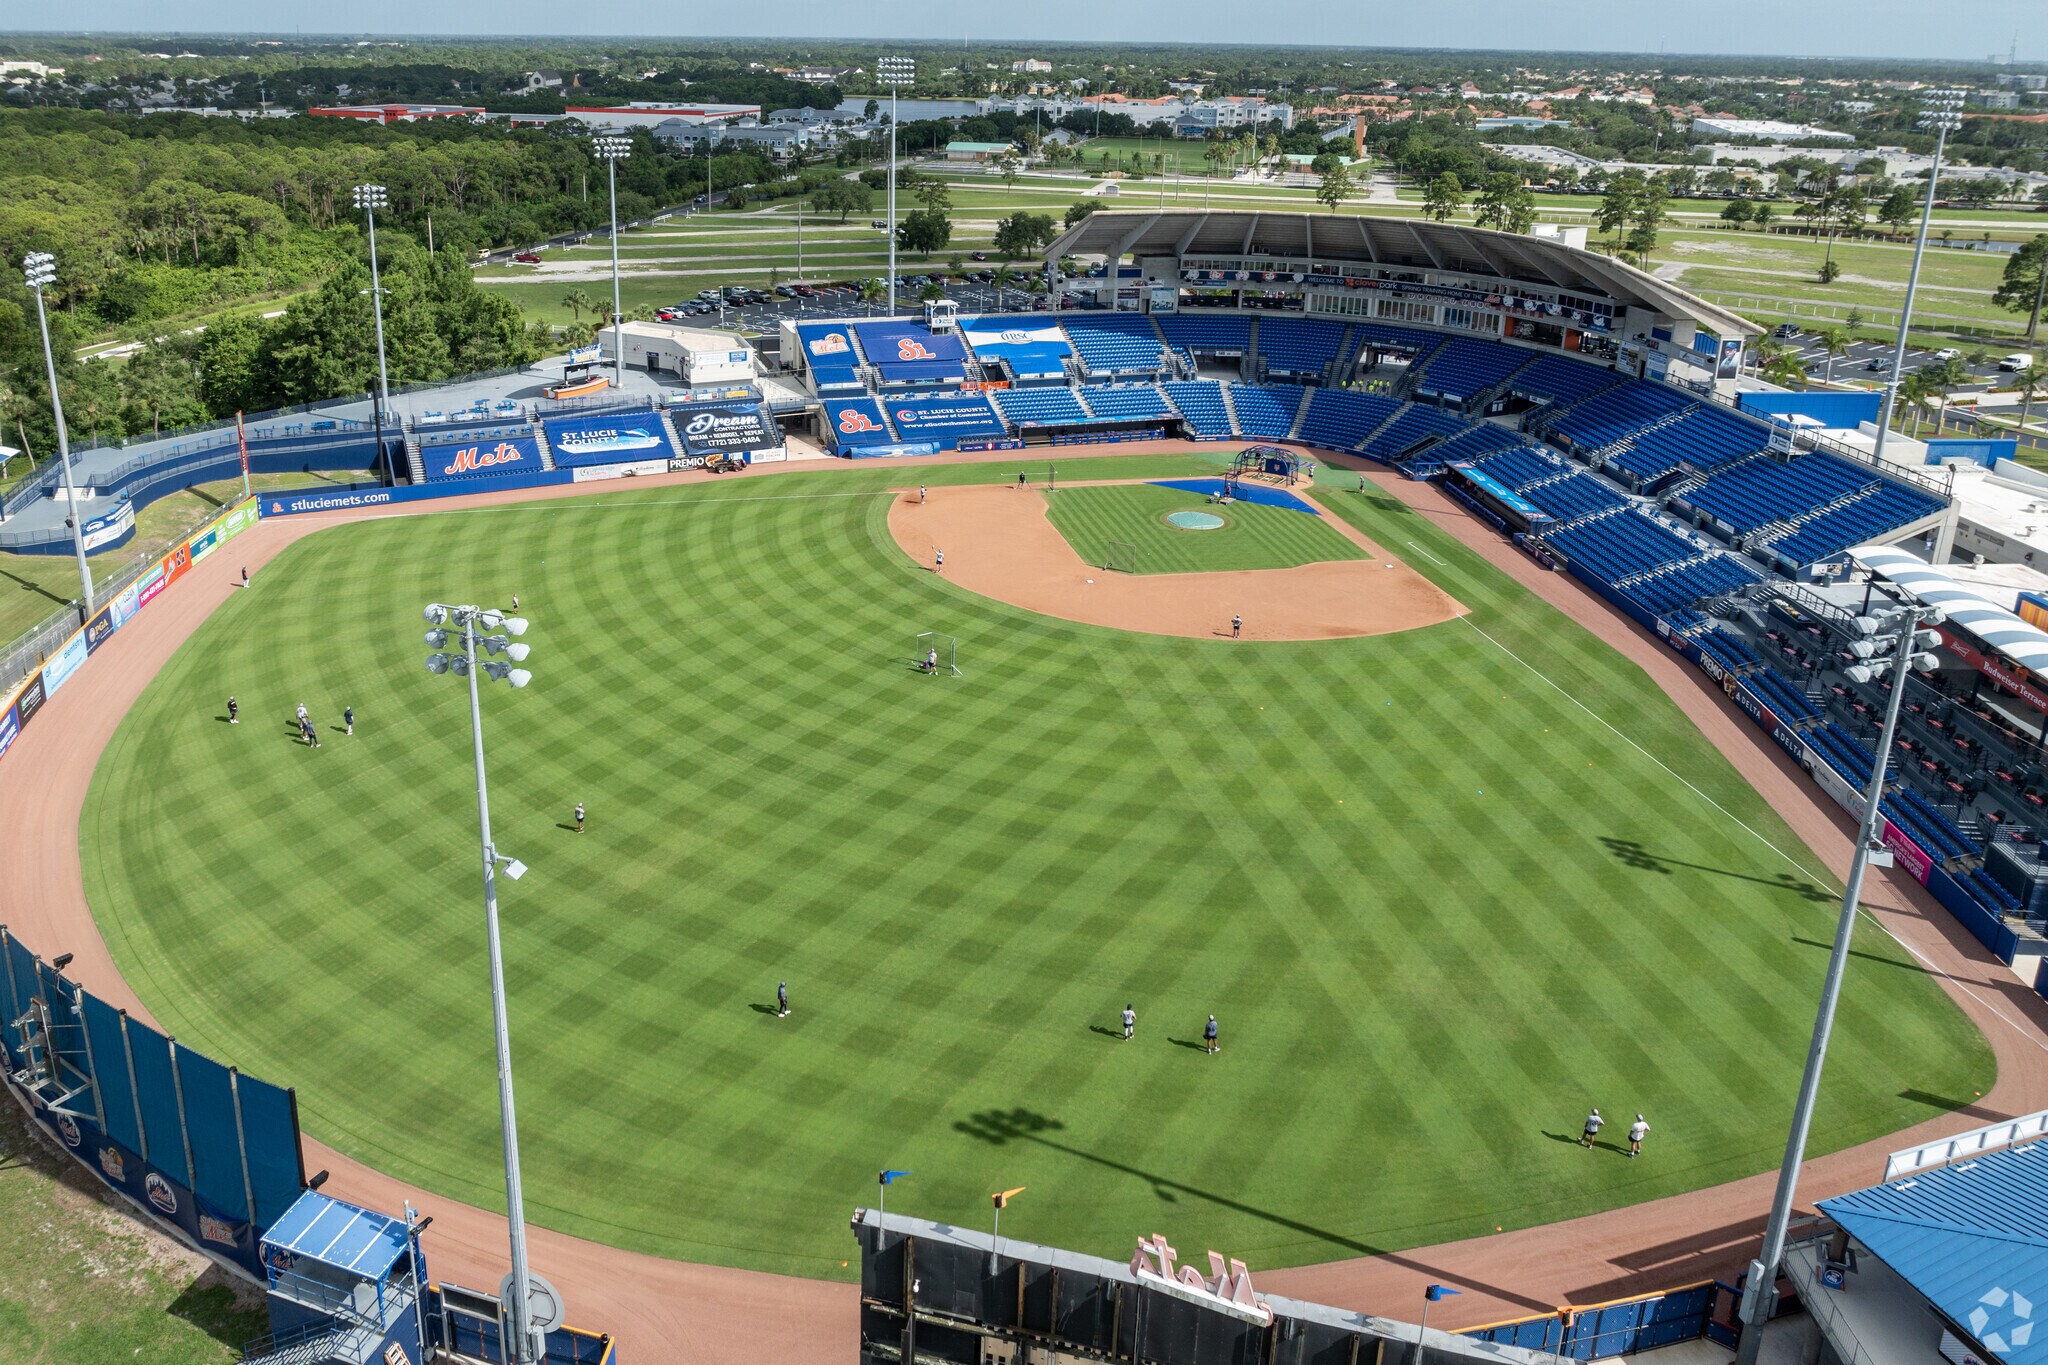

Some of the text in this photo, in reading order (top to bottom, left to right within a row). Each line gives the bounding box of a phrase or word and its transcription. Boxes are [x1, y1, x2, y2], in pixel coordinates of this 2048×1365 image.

[1401, 284, 1421, 292] SPRING
[1422, 286, 1446, 295] TRAINING
[1447, 290, 1463, 298] HOME
[685, 413, 758, 434] Dream
[714, 424, 761, 432] CONTRACTORS
[563, 436, 619, 446] COUNTY
[581, 429, 618, 438] LUCIE
[708, 439, 727, 447] (772)
[445, 443, 521, 474] Mets
[670, 457, 704, 468] PREMIO
[291, 492, 390, 511] stluciemets.com
[95, 618, 109, 636] PGA
[1701, 652, 1723, 680] PREMIO
[1983, 660, 2047, 709] Budweiser Terrace
[1740, 694, 1761, 720] DELTA
[1780, 732, 1801, 758] DELTA
[1893, 848, 1923, 881] NETWORK
[1907, 852, 1925, 872] LARGEST
